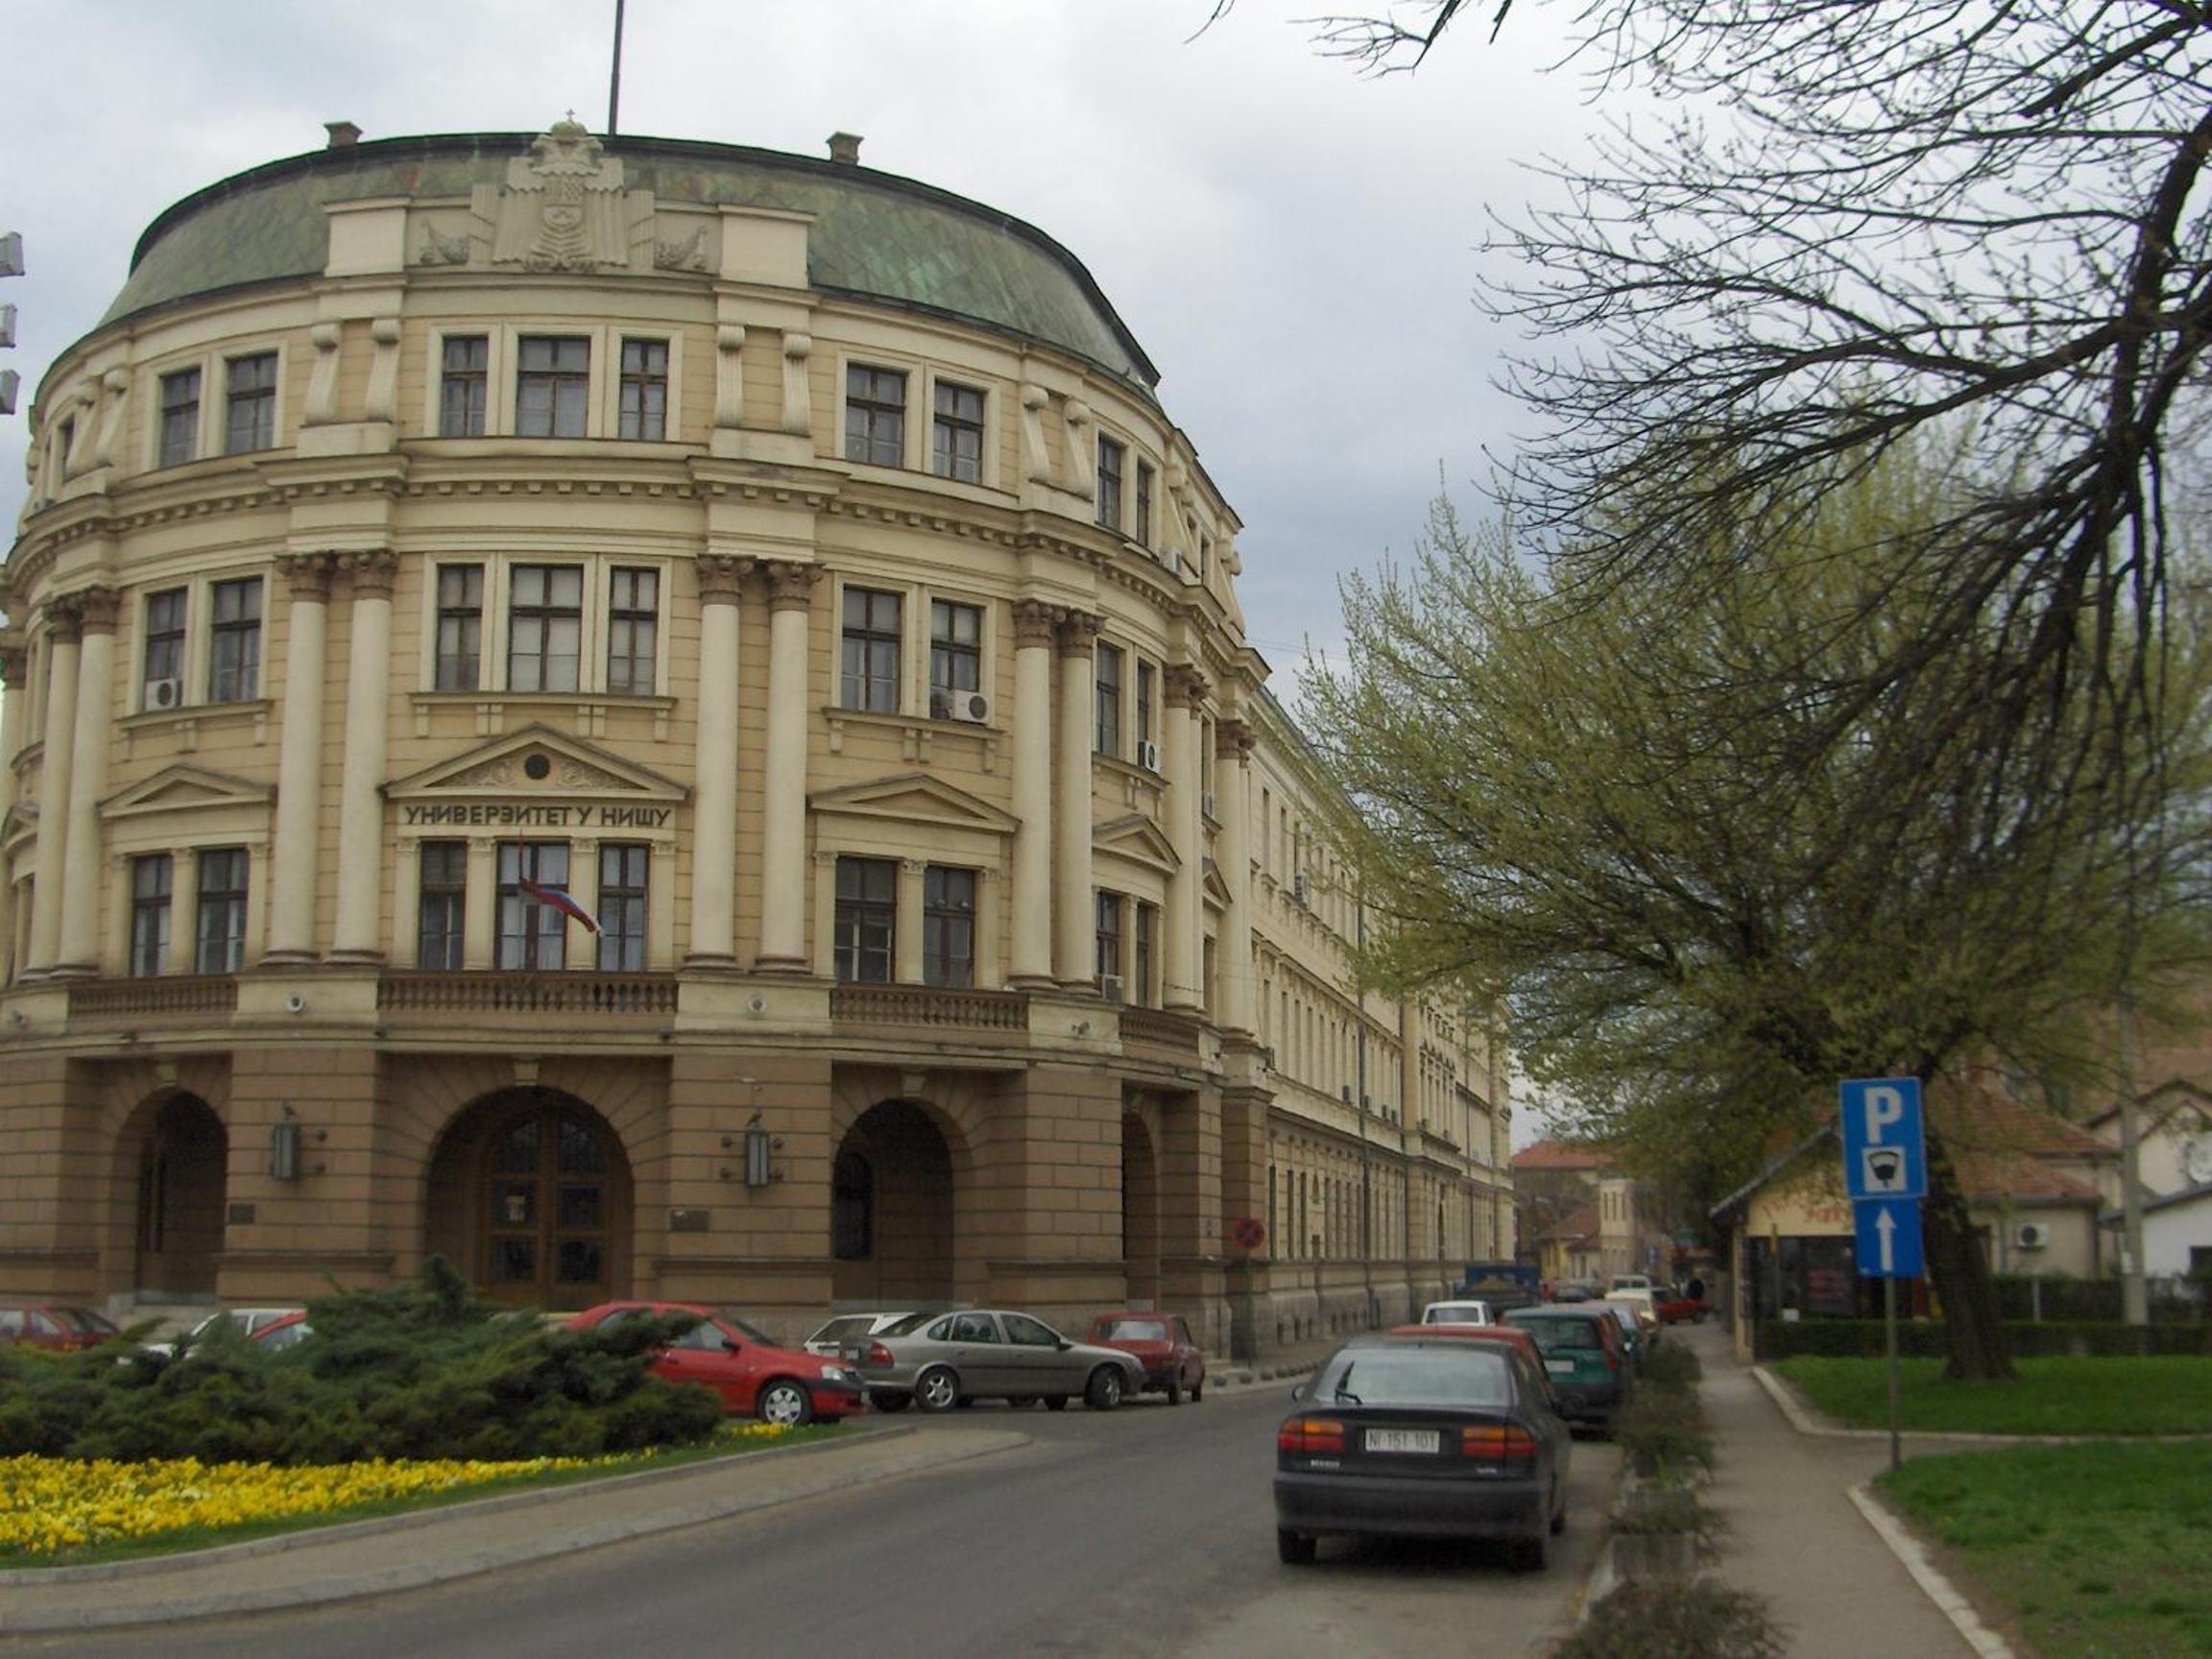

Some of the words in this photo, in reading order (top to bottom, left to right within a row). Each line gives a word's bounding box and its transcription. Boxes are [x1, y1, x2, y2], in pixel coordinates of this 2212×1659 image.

[405, 805, 572, 825] УНИВЕРЗИТЕТ
[576, 806, 593, 825] У
[600, 807, 671, 828] НИШУ
[1864, 1087, 1903, 1144] P
